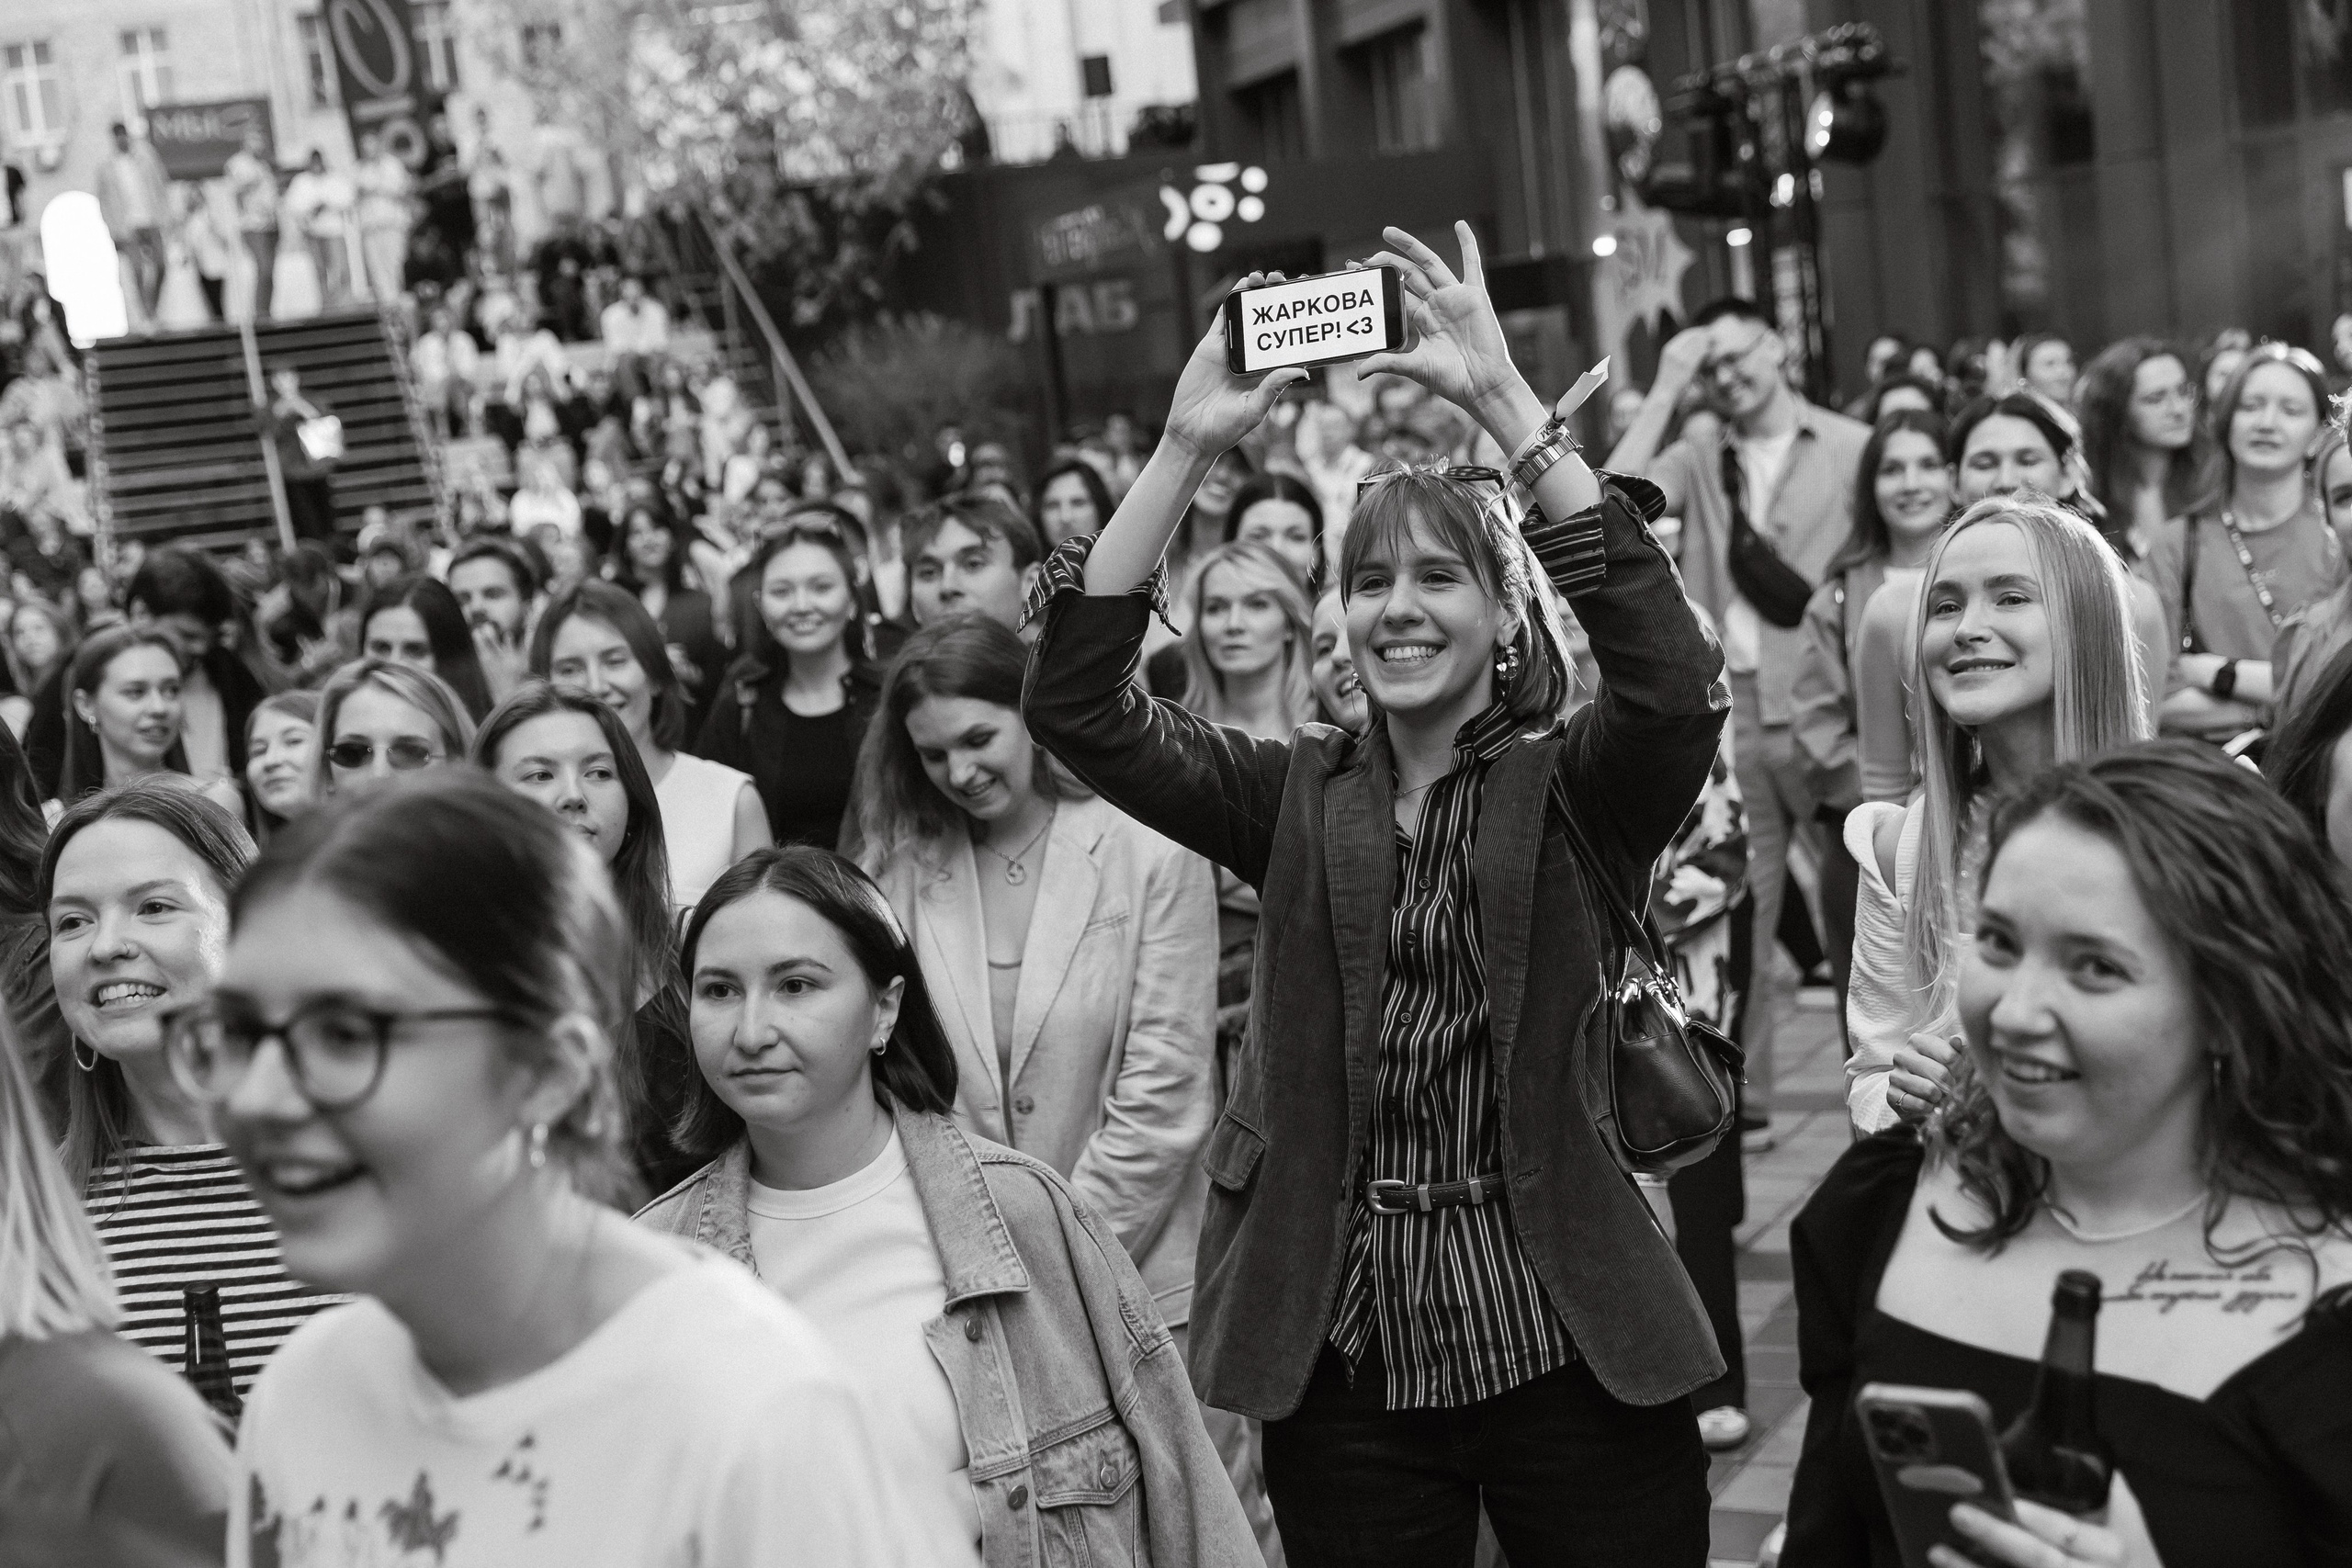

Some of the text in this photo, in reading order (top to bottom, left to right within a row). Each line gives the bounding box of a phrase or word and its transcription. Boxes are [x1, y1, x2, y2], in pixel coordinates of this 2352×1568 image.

[1251, 288, 1374, 326] ЖАРКОВА
[1256, 316, 1374, 352] СУПЕР! <3
